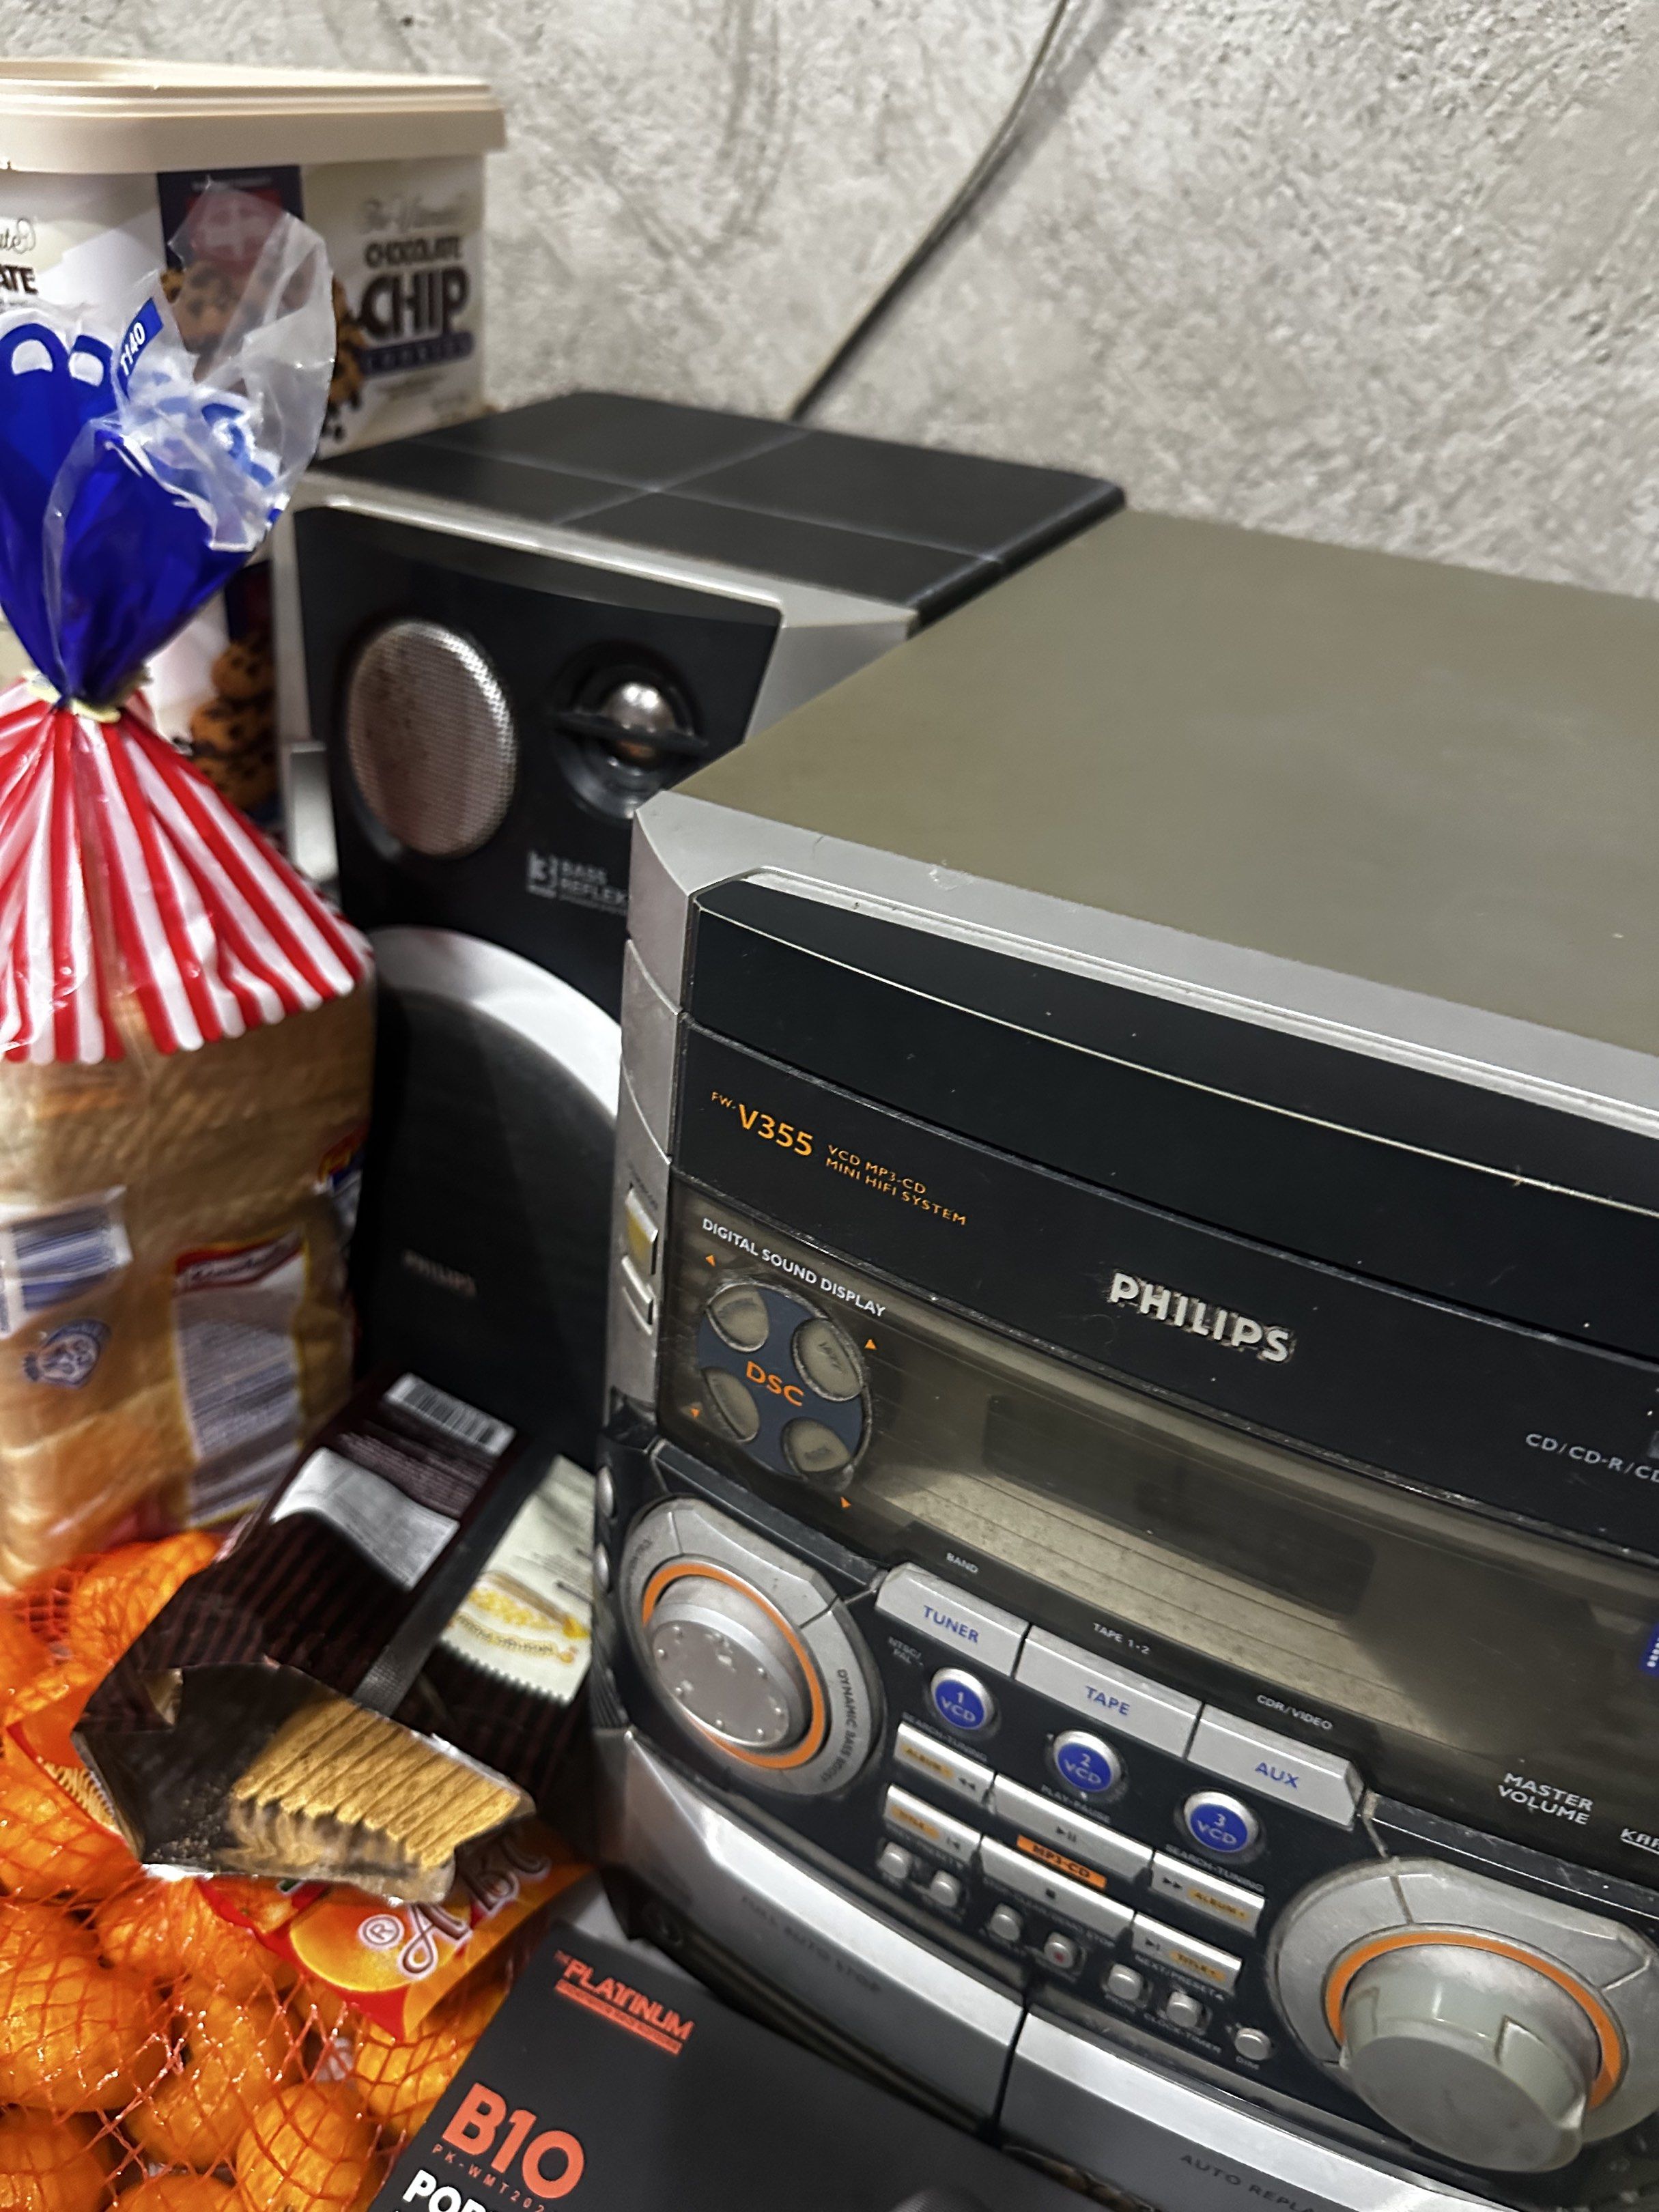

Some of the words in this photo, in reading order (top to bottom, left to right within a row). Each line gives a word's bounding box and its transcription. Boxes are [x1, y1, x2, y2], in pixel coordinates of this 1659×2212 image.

[361, 266, 469, 338] CHIP
[828, 1144, 861, 1166] VCD
[865, 1161, 927, 1194] MP3-CD
[825, 1158, 861, 1180] MINI
[865, 1176, 896, 1196] HIFI
[902, 1191, 967, 1226] SYSTEM
[703, 1217, 758, 1256] DIGITAL
[762, 1249, 817, 1284] SOUND
[821, 1277, 886, 1318] DISPLAY
[1109, 1272, 1289, 1362] PHILIPS
[746, 1361, 804, 1407] DSC
[946, 1552, 978, 1574] BAND
[923, 1604, 978, 1643] TUNER
[1093, 1622, 1123, 1643] TAPE
[1127, 1639, 1150, 1655] 1-2
[837, 1669, 857, 1728] DYNAMIC
[941, 1695, 976, 1722] VCD
[957, 1691, 965, 1704] 1
[1086, 1686, 1130, 1715] TAPE
[1256, 1695, 1333, 1730] CDR/VIDEO
[1064, 1759, 1101, 1783] VCD
[1081, 1753, 1091, 1767] 2
[1255, 1762, 1299, 1789] AUX
[1498, 1785, 1590, 1825] VOLUME
[1503, 1772, 1593, 1811] MASTER
[1197, 1820, 1237, 1844] VCD
[1214, 1813, 1226, 1828] 3
[563, 1958, 695, 2040] PLATINUM
[442, 2082, 585, 2199] B10
[1180, 2154, 1241, 2185] AUTO
